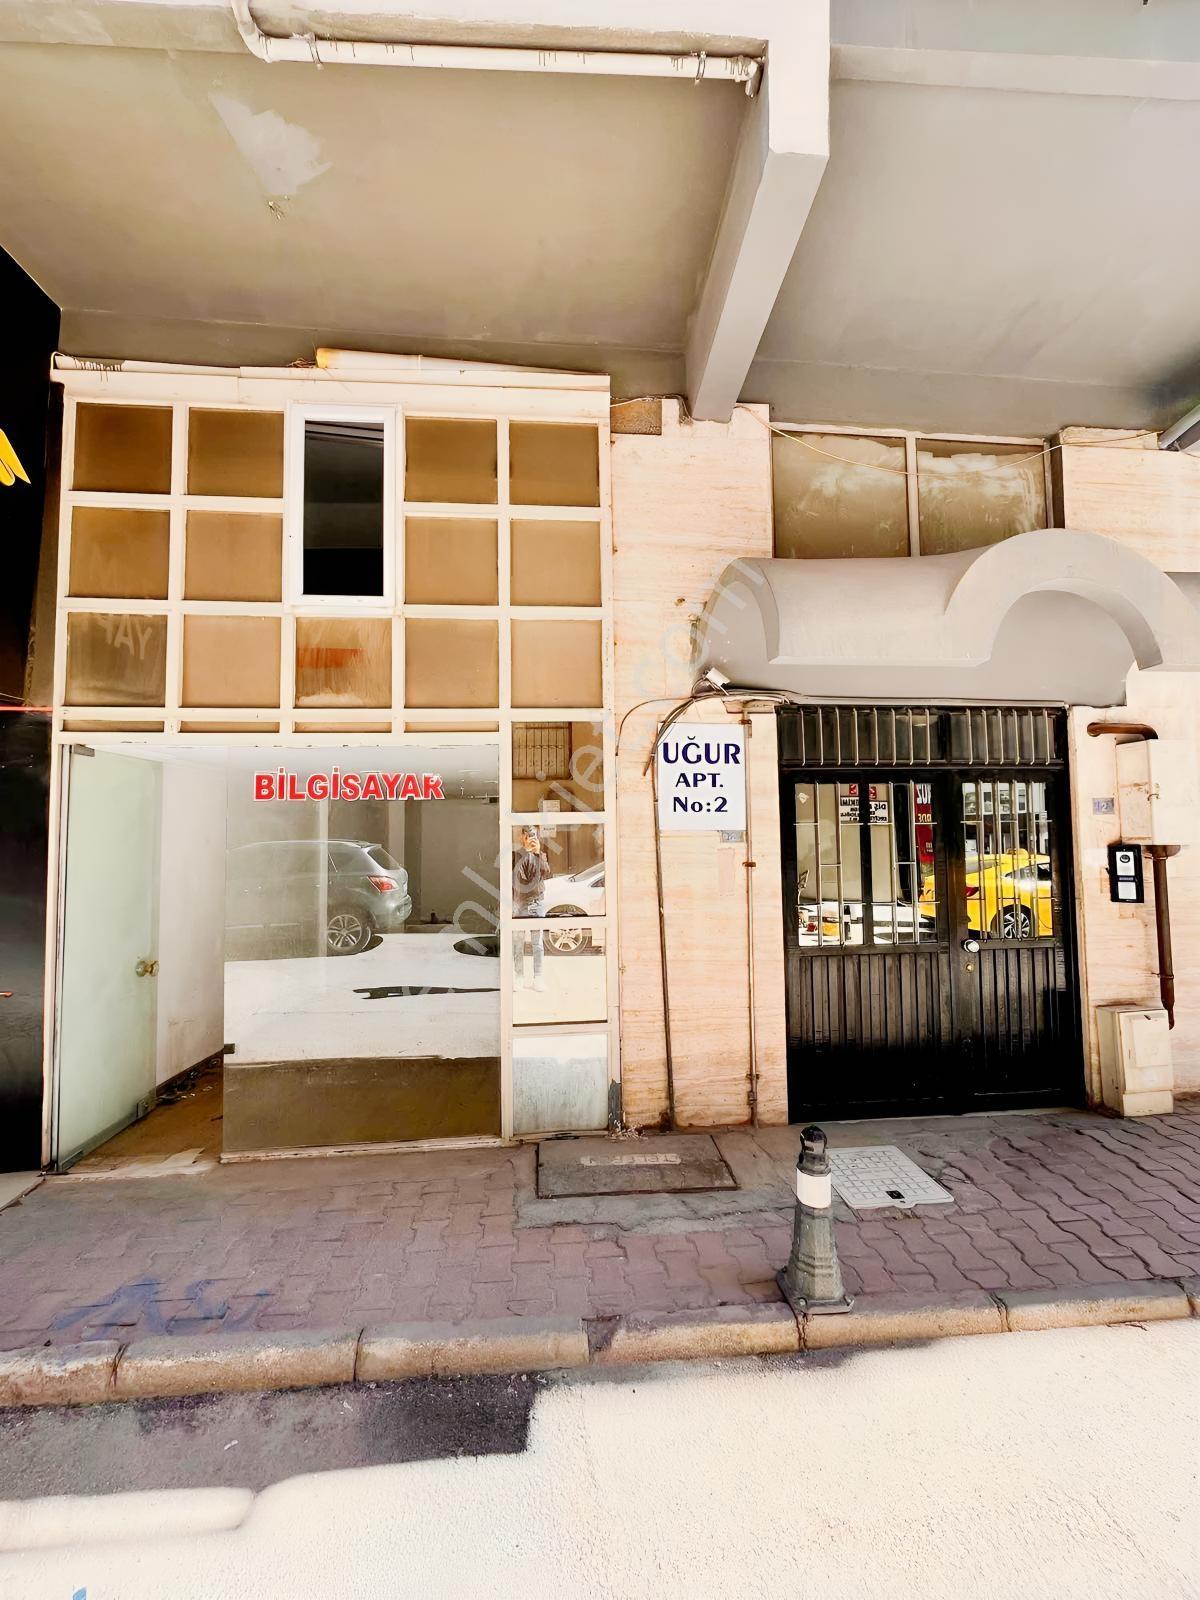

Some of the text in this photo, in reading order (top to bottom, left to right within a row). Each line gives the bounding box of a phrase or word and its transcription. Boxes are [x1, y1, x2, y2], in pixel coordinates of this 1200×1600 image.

[662, 735, 741, 764] UĞUR
[254, 767, 444, 801] BİLGİSAYAR
[675, 773, 724, 788] APT.
[673, 796, 728, 813] No:2
